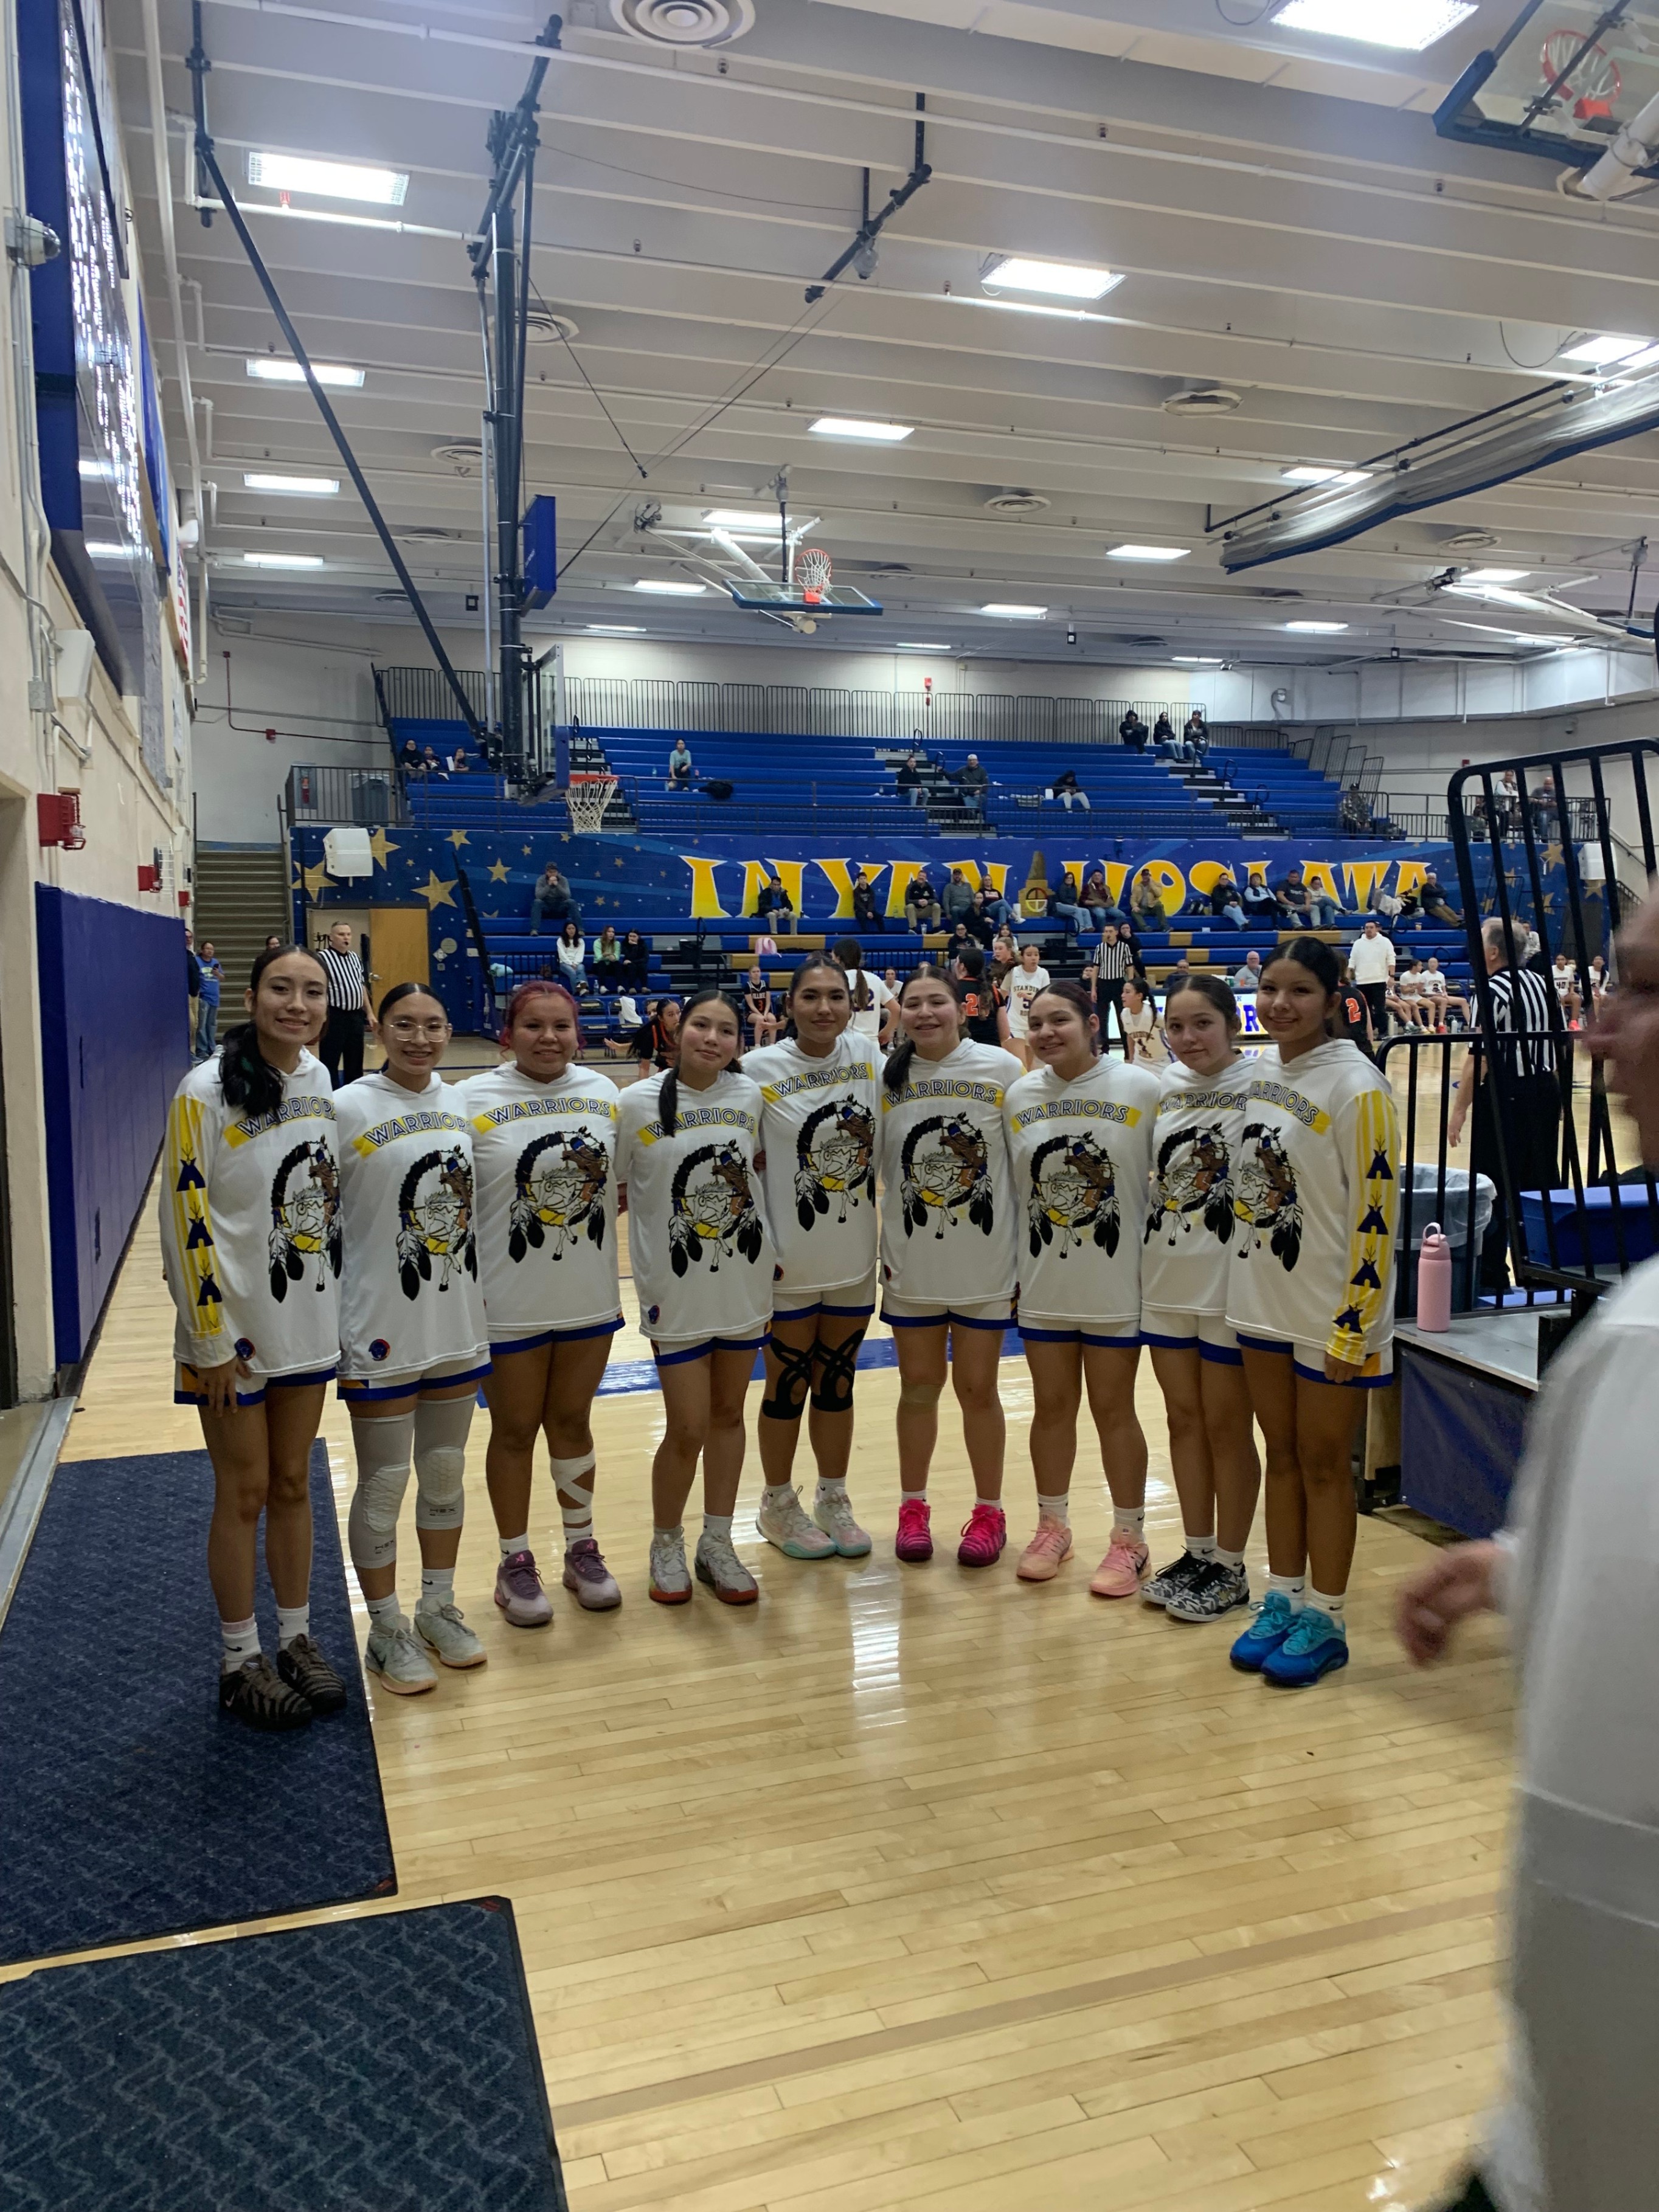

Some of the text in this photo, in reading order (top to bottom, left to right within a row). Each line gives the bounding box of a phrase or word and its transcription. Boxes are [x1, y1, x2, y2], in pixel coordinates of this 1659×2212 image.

[771, 1062, 868, 1098] WARRIORS
[884, 1079, 998, 1108] WARRIORS
[232, 1096, 337, 1139] WARRIOR
[483, 1097, 611, 1125] WARRIORS
[1015, 1099, 1129, 1128] WARRIORS
[1159, 1091, 1249, 1115] WARRIOR
[1252, 1080, 1319, 1126] ARRIORS
[363, 1111, 469, 1147] WARRIOR
